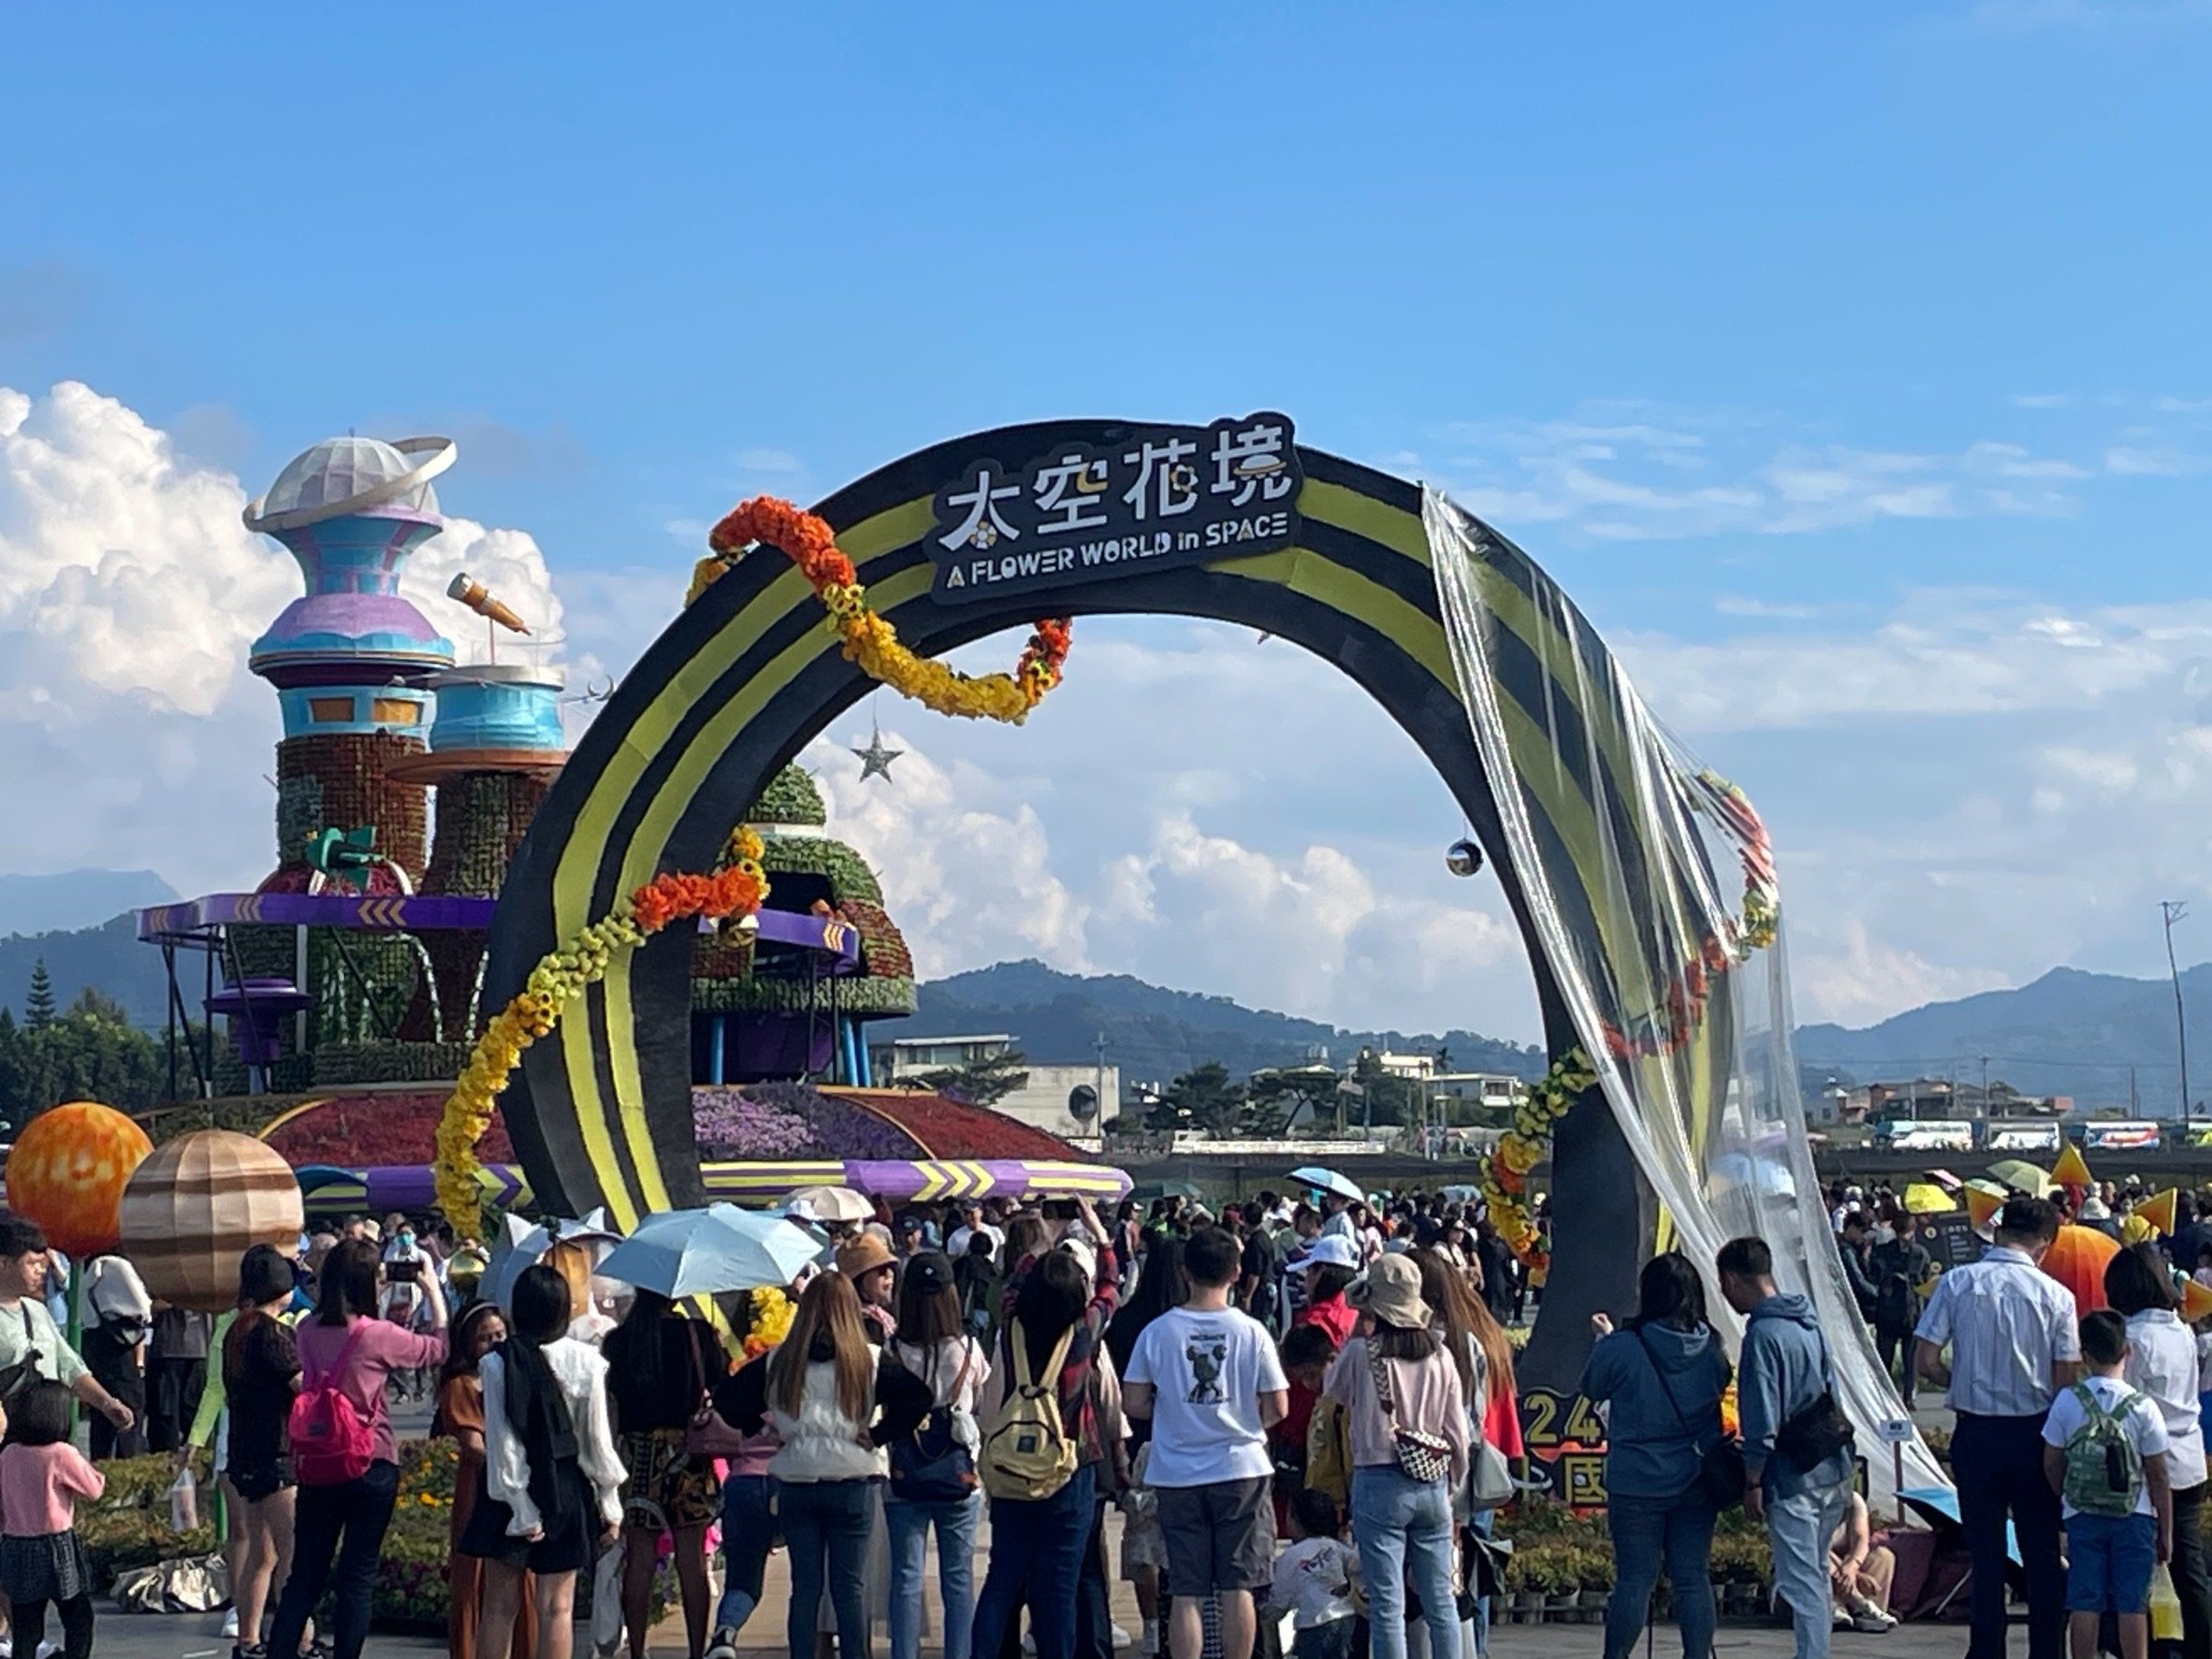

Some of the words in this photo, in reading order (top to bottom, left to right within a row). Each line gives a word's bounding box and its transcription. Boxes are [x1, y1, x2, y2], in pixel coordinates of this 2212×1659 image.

[939, 424, 1293, 552] 太空花境
[946, 566, 966, 589] A
[970, 546, 1074, 585] FLOWER
[1080, 530, 1171, 567] WORLD
[1177, 531, 1200, 551] in
[1205, 512, 1288, 547] SPACE
